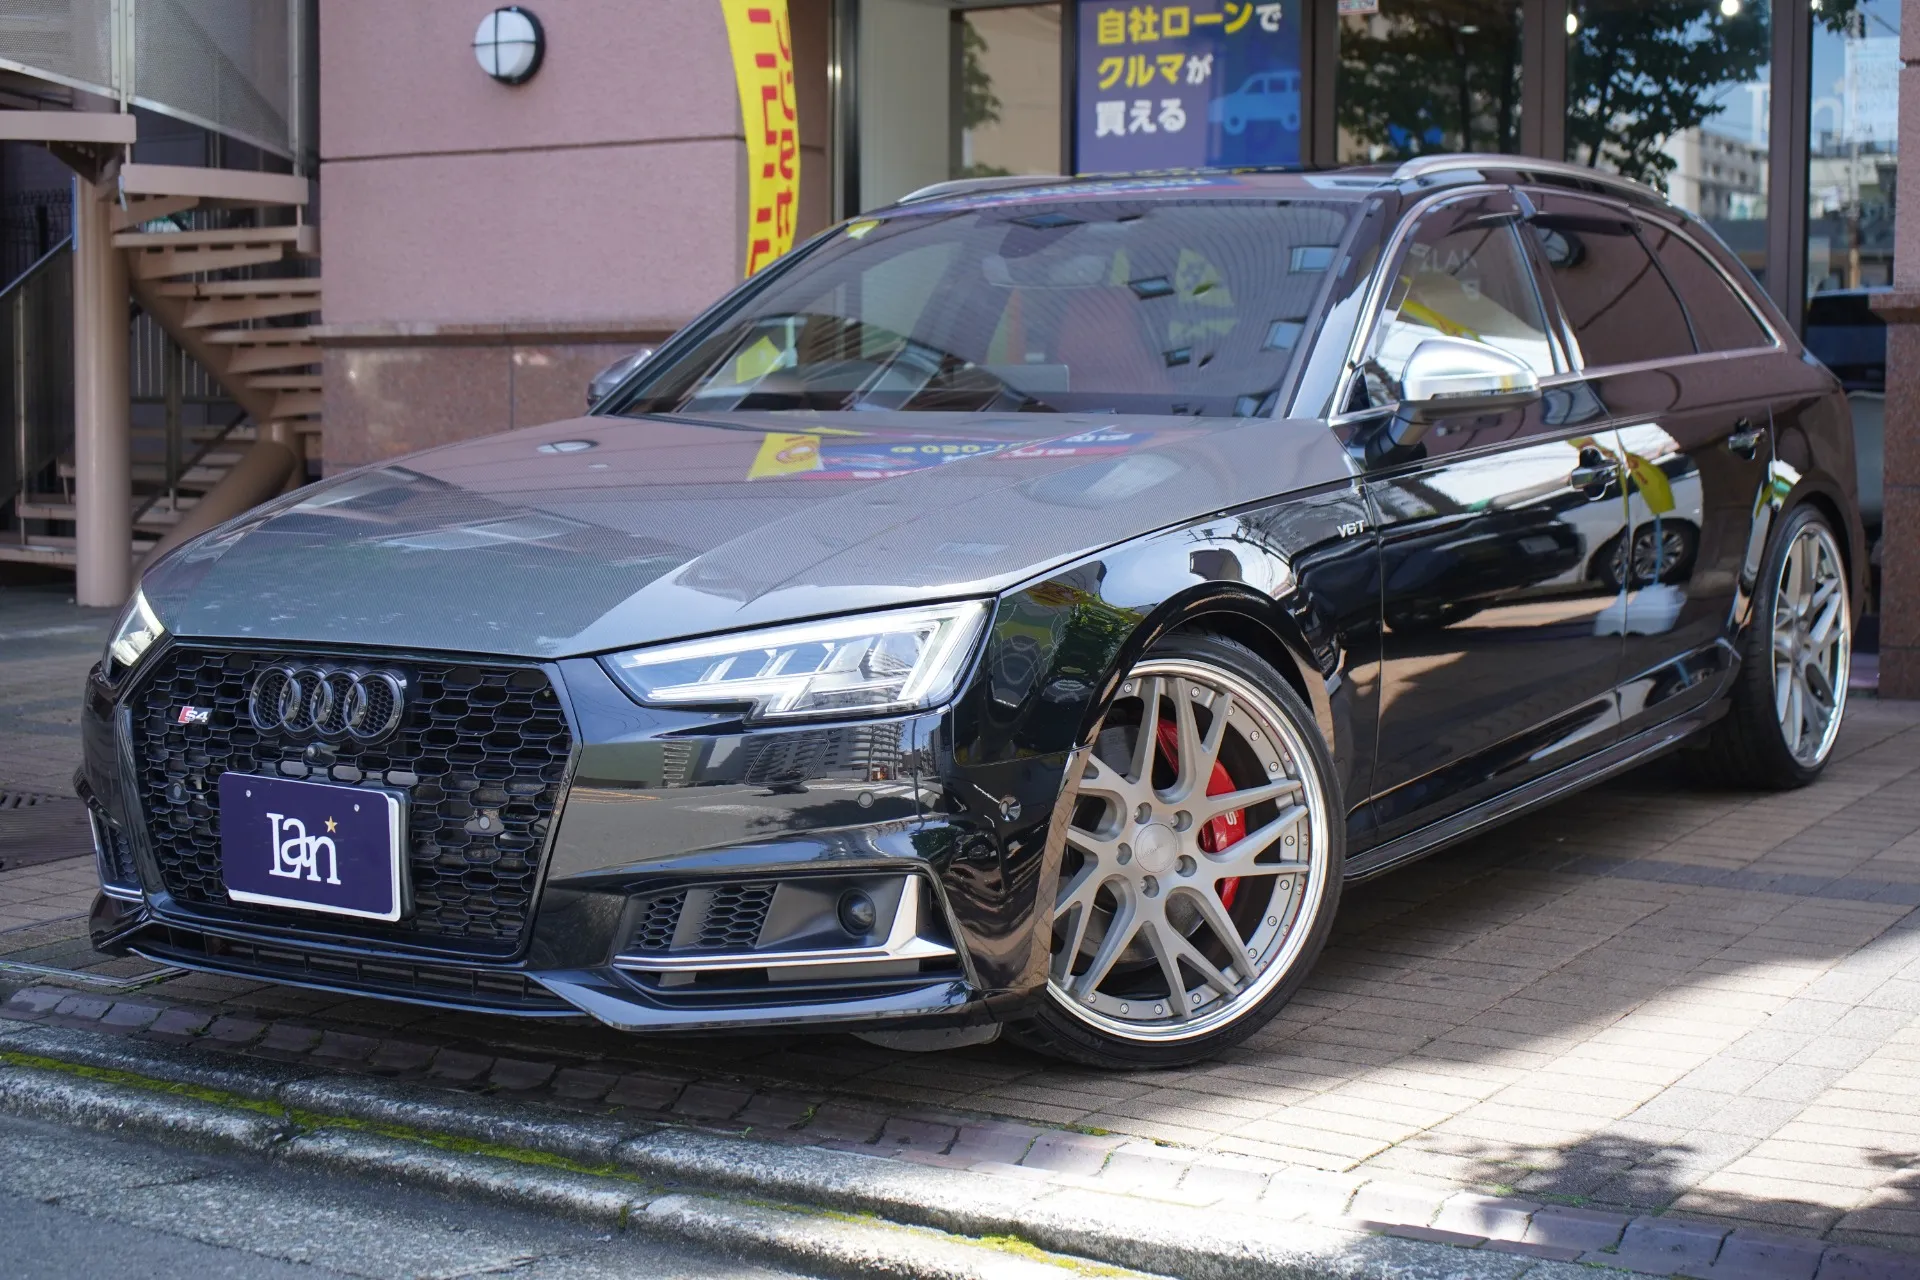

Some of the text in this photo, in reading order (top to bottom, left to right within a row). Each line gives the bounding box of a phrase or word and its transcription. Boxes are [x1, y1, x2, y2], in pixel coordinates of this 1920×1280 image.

[1097, 2, 1283, 45] 自社ローンで
[1097, 53, 1214, 90] クルマが
[1095, 98, 1187, 137] 買える
[184, 710, 209, 723] S4
